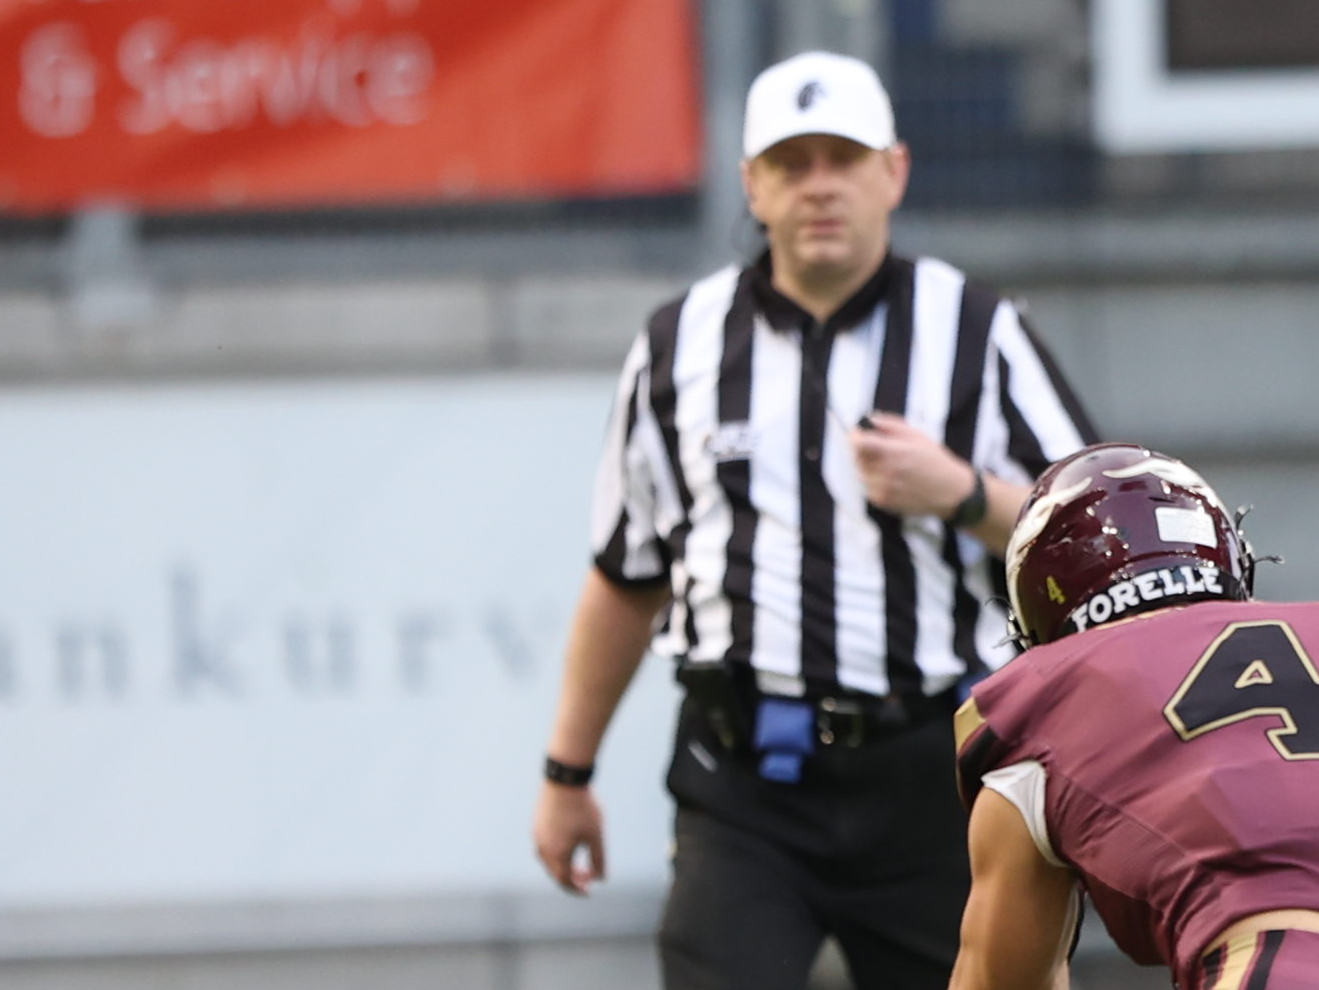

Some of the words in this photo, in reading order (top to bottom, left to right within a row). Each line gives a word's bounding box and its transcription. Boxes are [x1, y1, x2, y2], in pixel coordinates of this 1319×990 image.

[116, 18, 434, 134] Service
[0, 560, 548, 699] nkurv
[1046, 575, 1067, 605] 4
[1070, 564, 1224, 633] FORELLE
